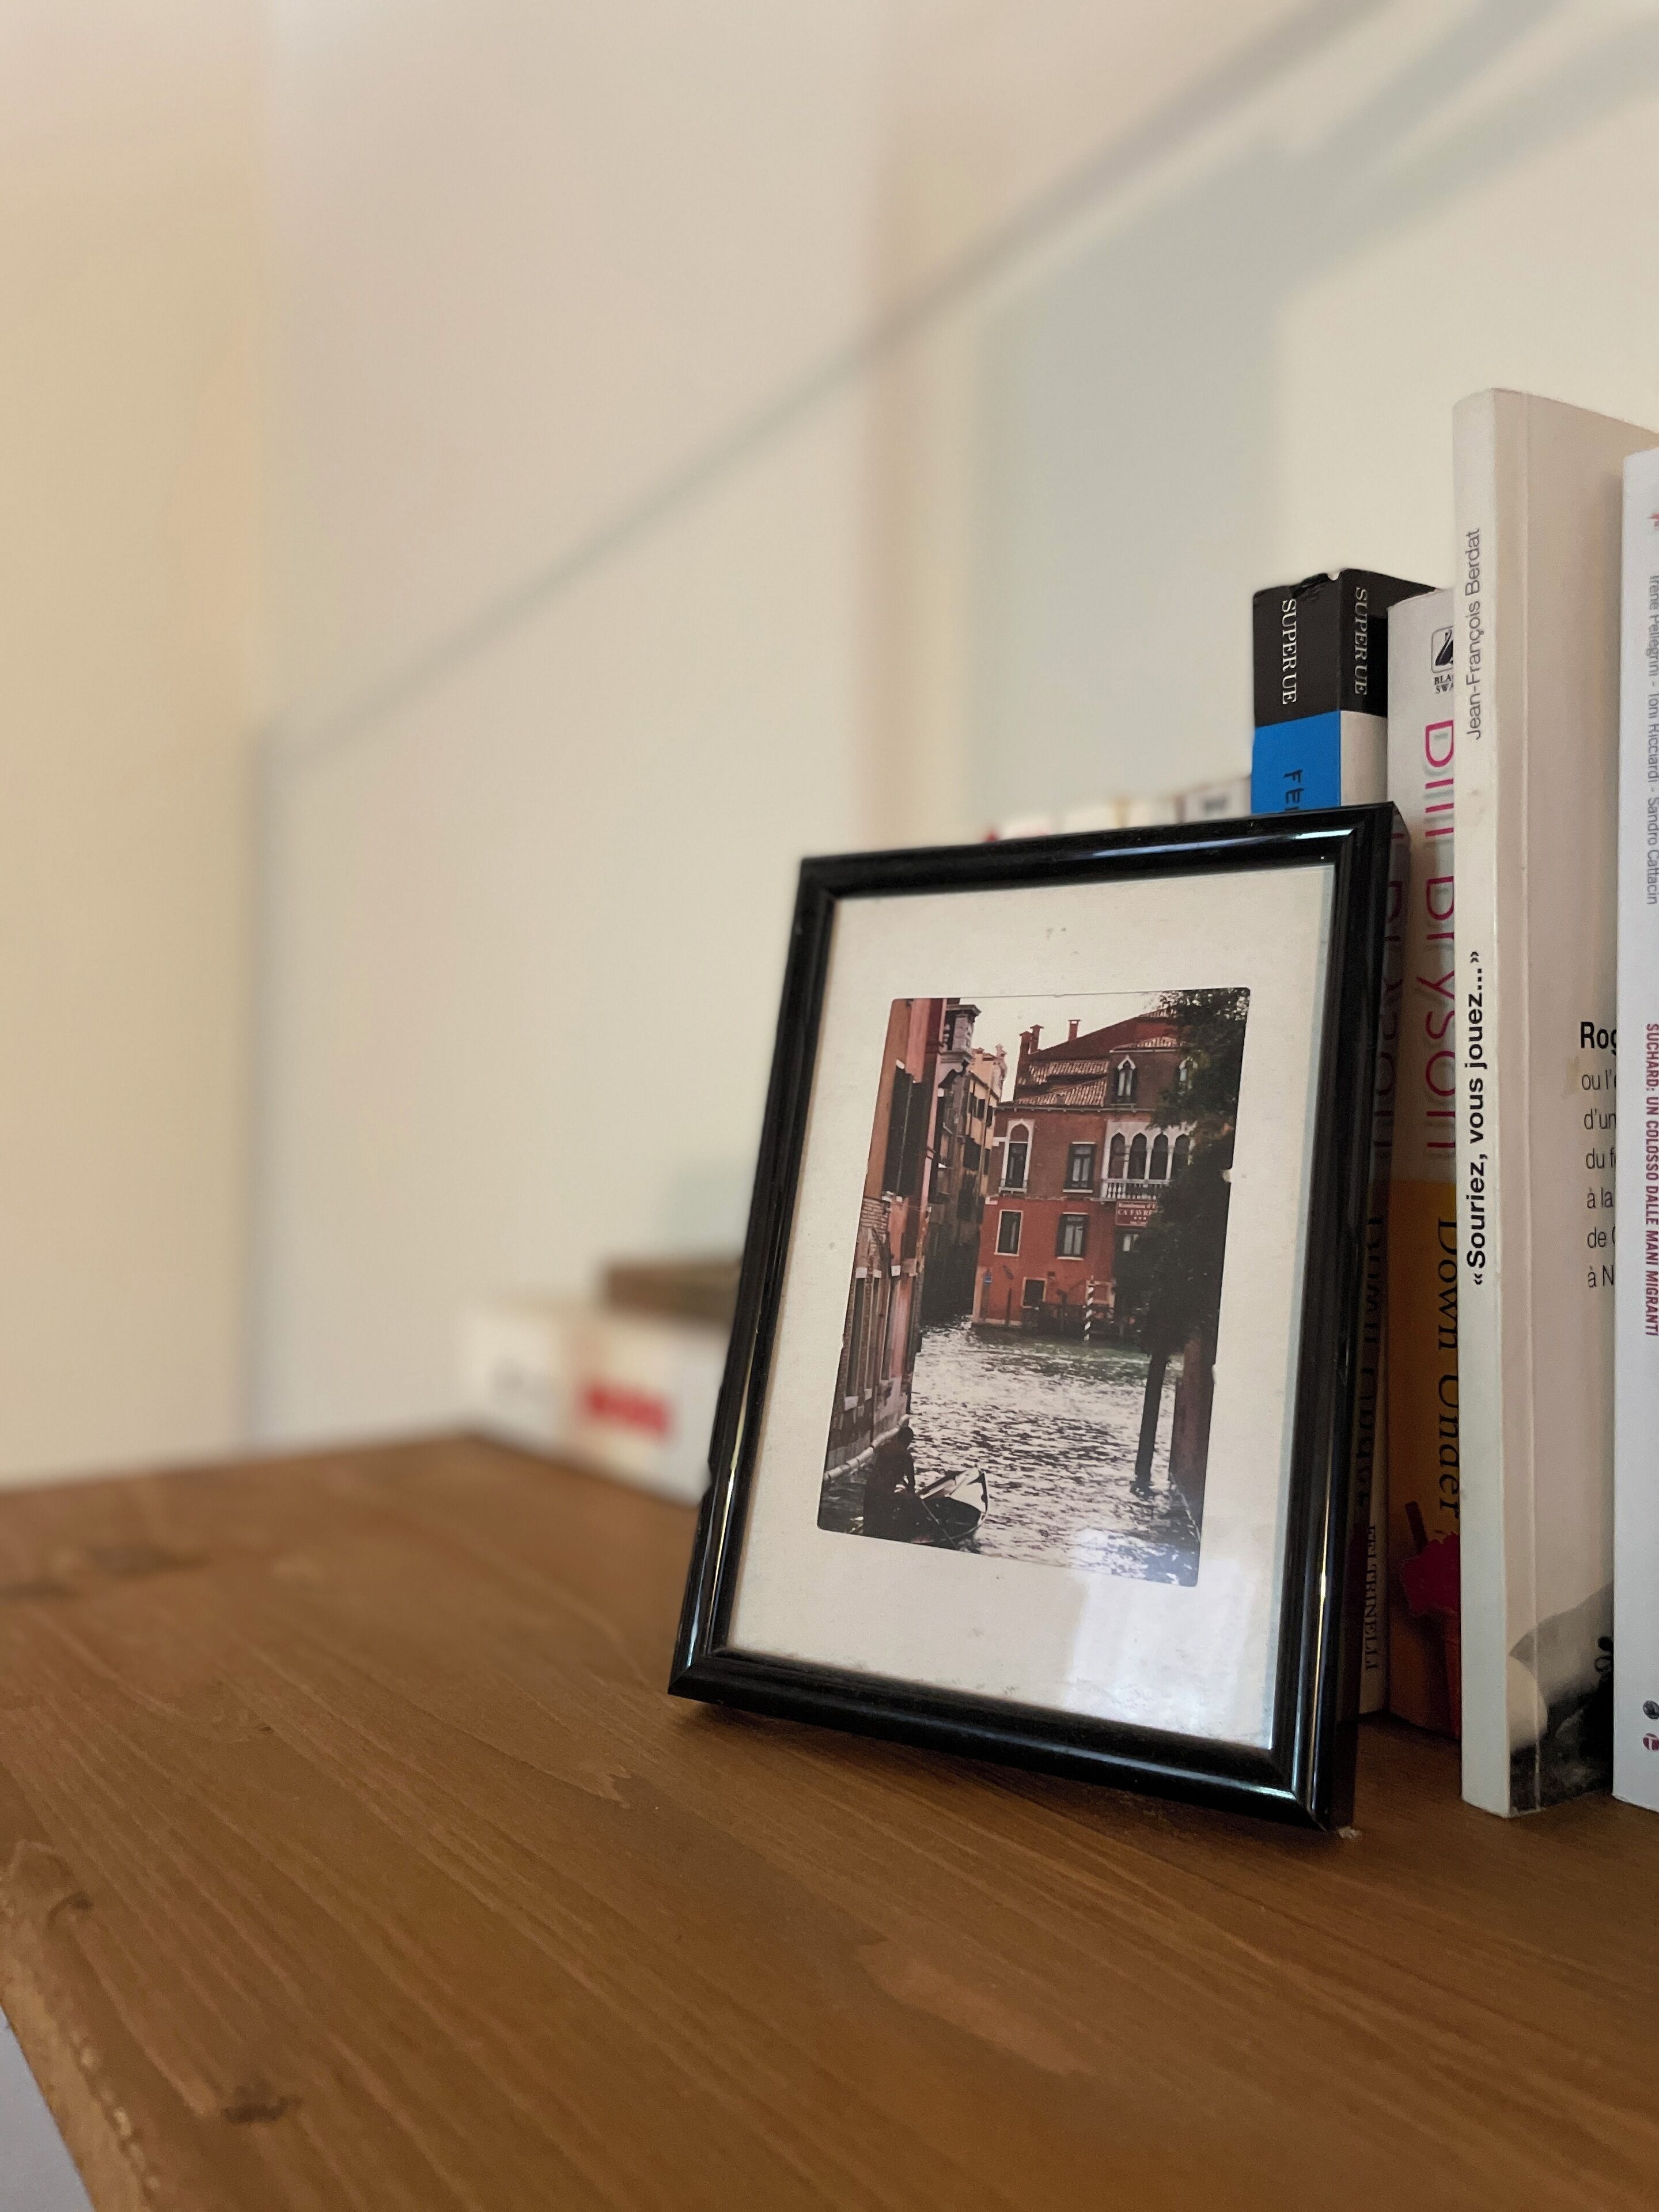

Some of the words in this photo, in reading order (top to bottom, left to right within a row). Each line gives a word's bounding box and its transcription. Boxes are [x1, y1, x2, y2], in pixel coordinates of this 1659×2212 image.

[1465, 528, 1480, 596] Berdat
[1282, 599, 1297, 672] SUPER
[1354, 587, 1368, 661] SUPER
[1282, 672, 1297, 704] UE
[1354, 664, 1368, 695] UE
[1434, 674, 1453, 685] BLA
[1466, 600, 1484, 741] Jean-François
[1283, 769, 1304, 813] FE
[1647, 797, 1659, 845] Sandro
[1646, 850, 1659, 904] Cattacin
[1580, 1021, 1616, 1056] Rog
[1646, 1023, 1659, 1091] SUCHARD:
[1581, 1074, 1600, 1090] ou
[1605, 1069, 1616, 1090] l'
[1469, 1078, 1484, 1144] vous
[1646, 1096, 1659, 1115] UN
[1586, 1148, 1605, 1169] du
[1646, 1120, 1659, 1180] COLOSSO
[1587, 1187, 1596, 1209] à
[1646, 1185, 1659, 1225] DALLE
[1587, 1227, 1606, 1248] de
[1646, 1230, 1659, 1265] MANI
[1438, 1217, 1458, 1350] Down
[1588, 1266, 1597, 1288] à
[1645, 1271, 1659, 1335] MIGRANTI
[1440, 1373, 1460, 1519] Under
